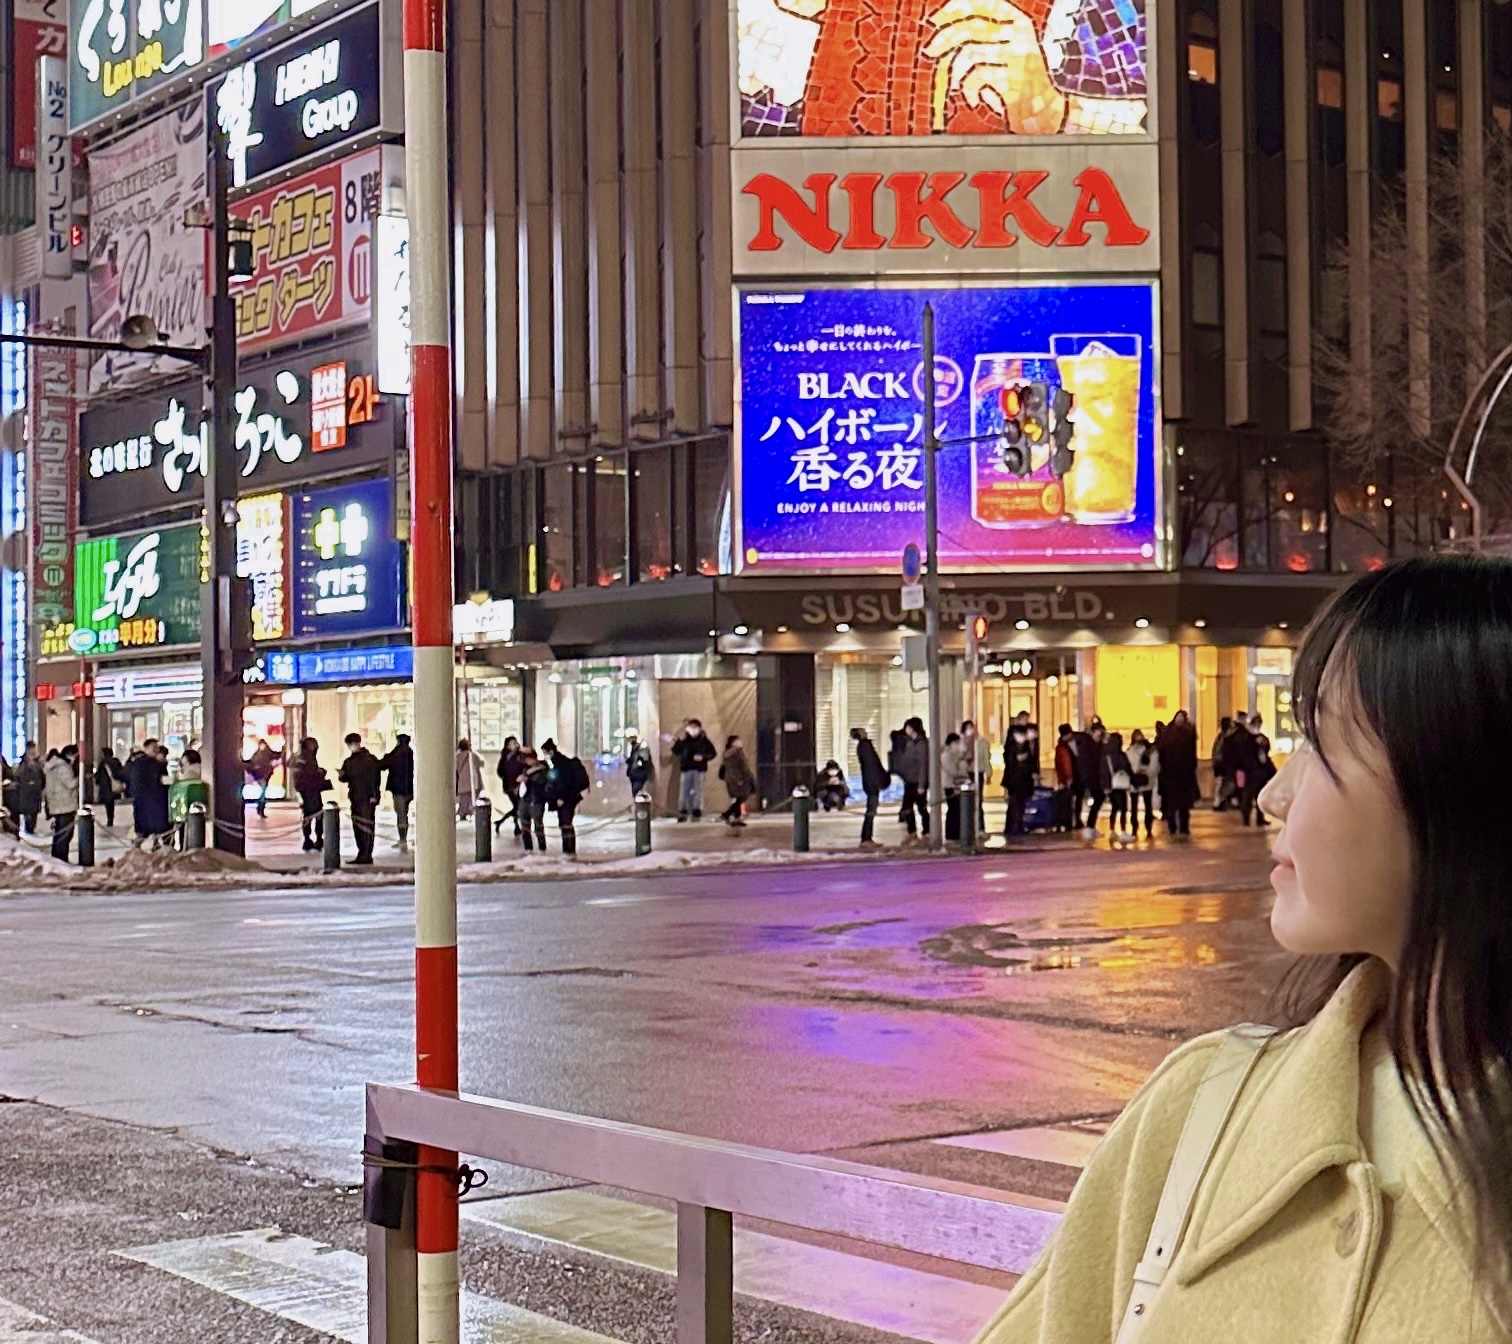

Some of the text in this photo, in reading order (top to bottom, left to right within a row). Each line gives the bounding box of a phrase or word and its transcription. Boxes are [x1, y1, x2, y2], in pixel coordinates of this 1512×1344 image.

[741, 166, 1151, 254] NIKKA
[797, 371, 910, 400] BLACK
[785, 443, 924, 493] 香る夜
[776, 500, 926, 515] ENJOY A RELAXING NIGH
